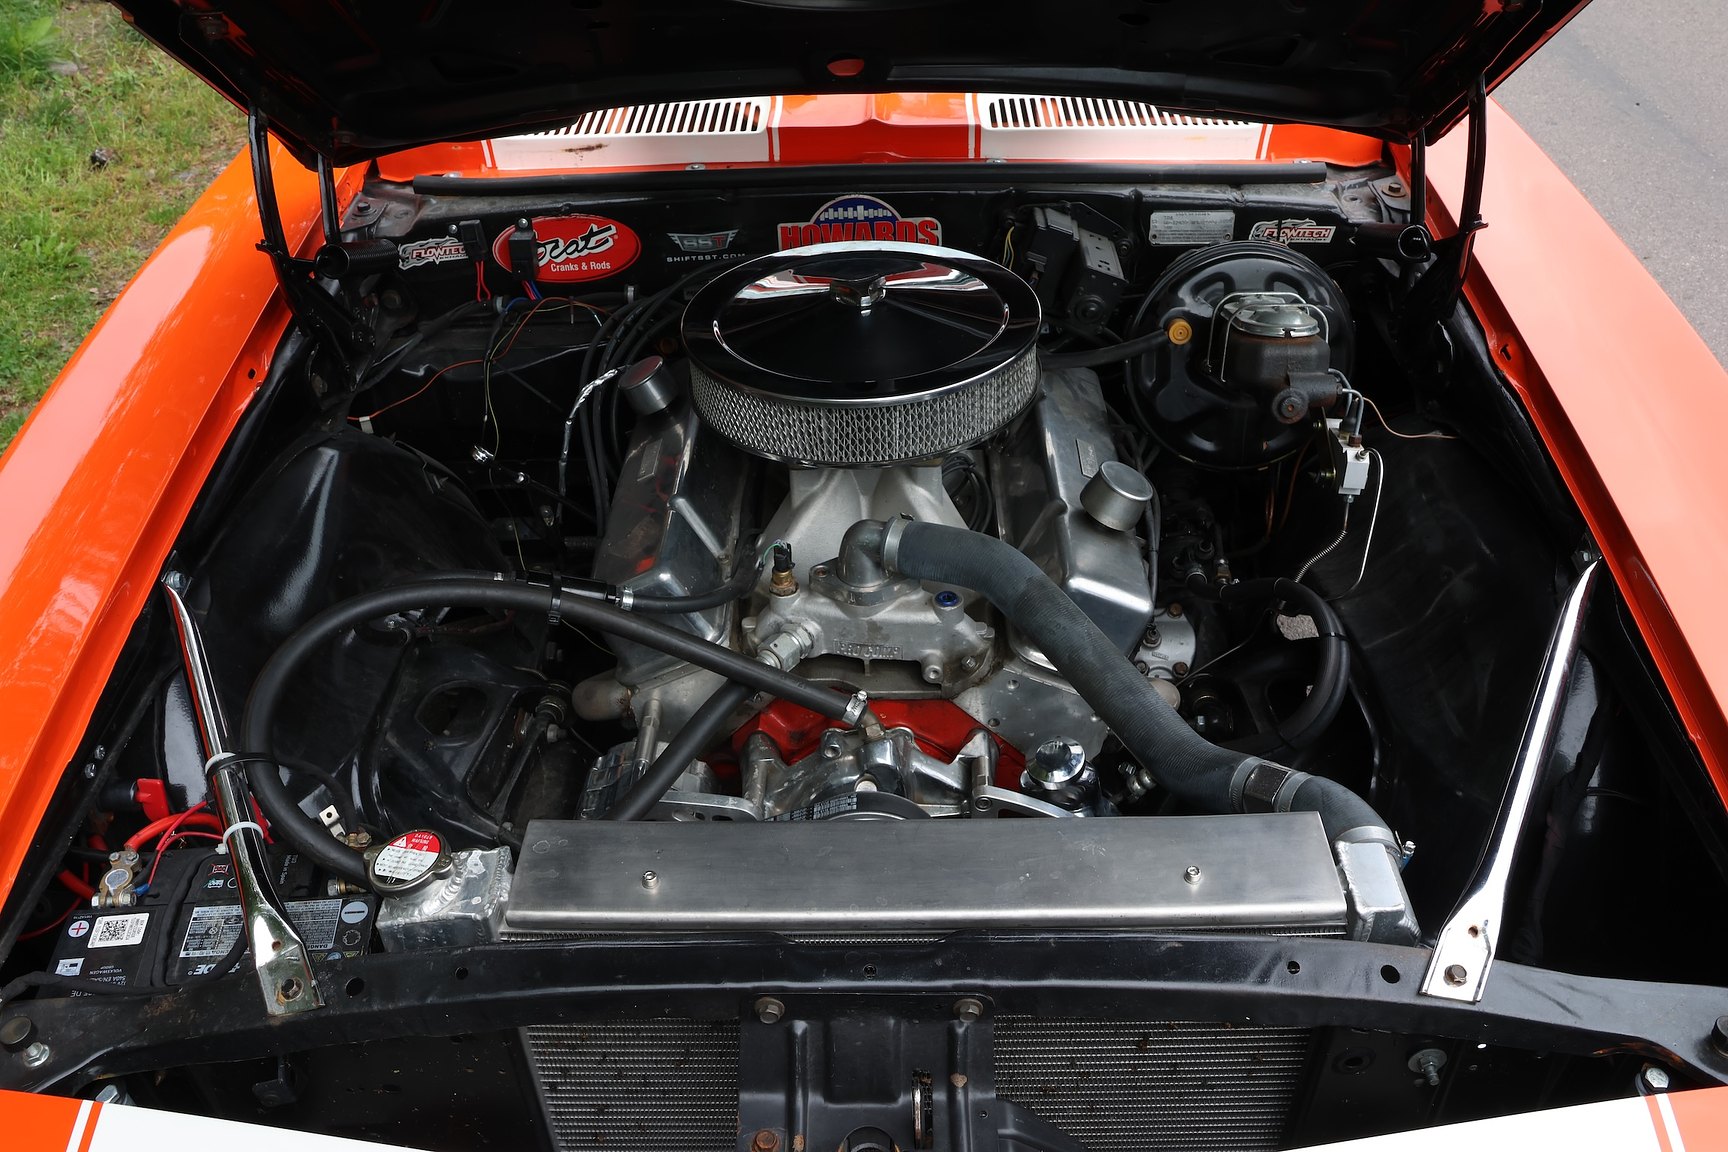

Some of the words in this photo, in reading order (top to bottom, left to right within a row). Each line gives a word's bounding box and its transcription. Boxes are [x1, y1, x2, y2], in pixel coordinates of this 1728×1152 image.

[683, 235, 726, 249] SST
[780, 220, 939, 250] HOWARDS
[412, 245, 466, 261] FLOWTEC
[550, 262, 579, 272] Cranks
[581, 262, 588, 271] &
[590, 260, 611, 270] Rods
